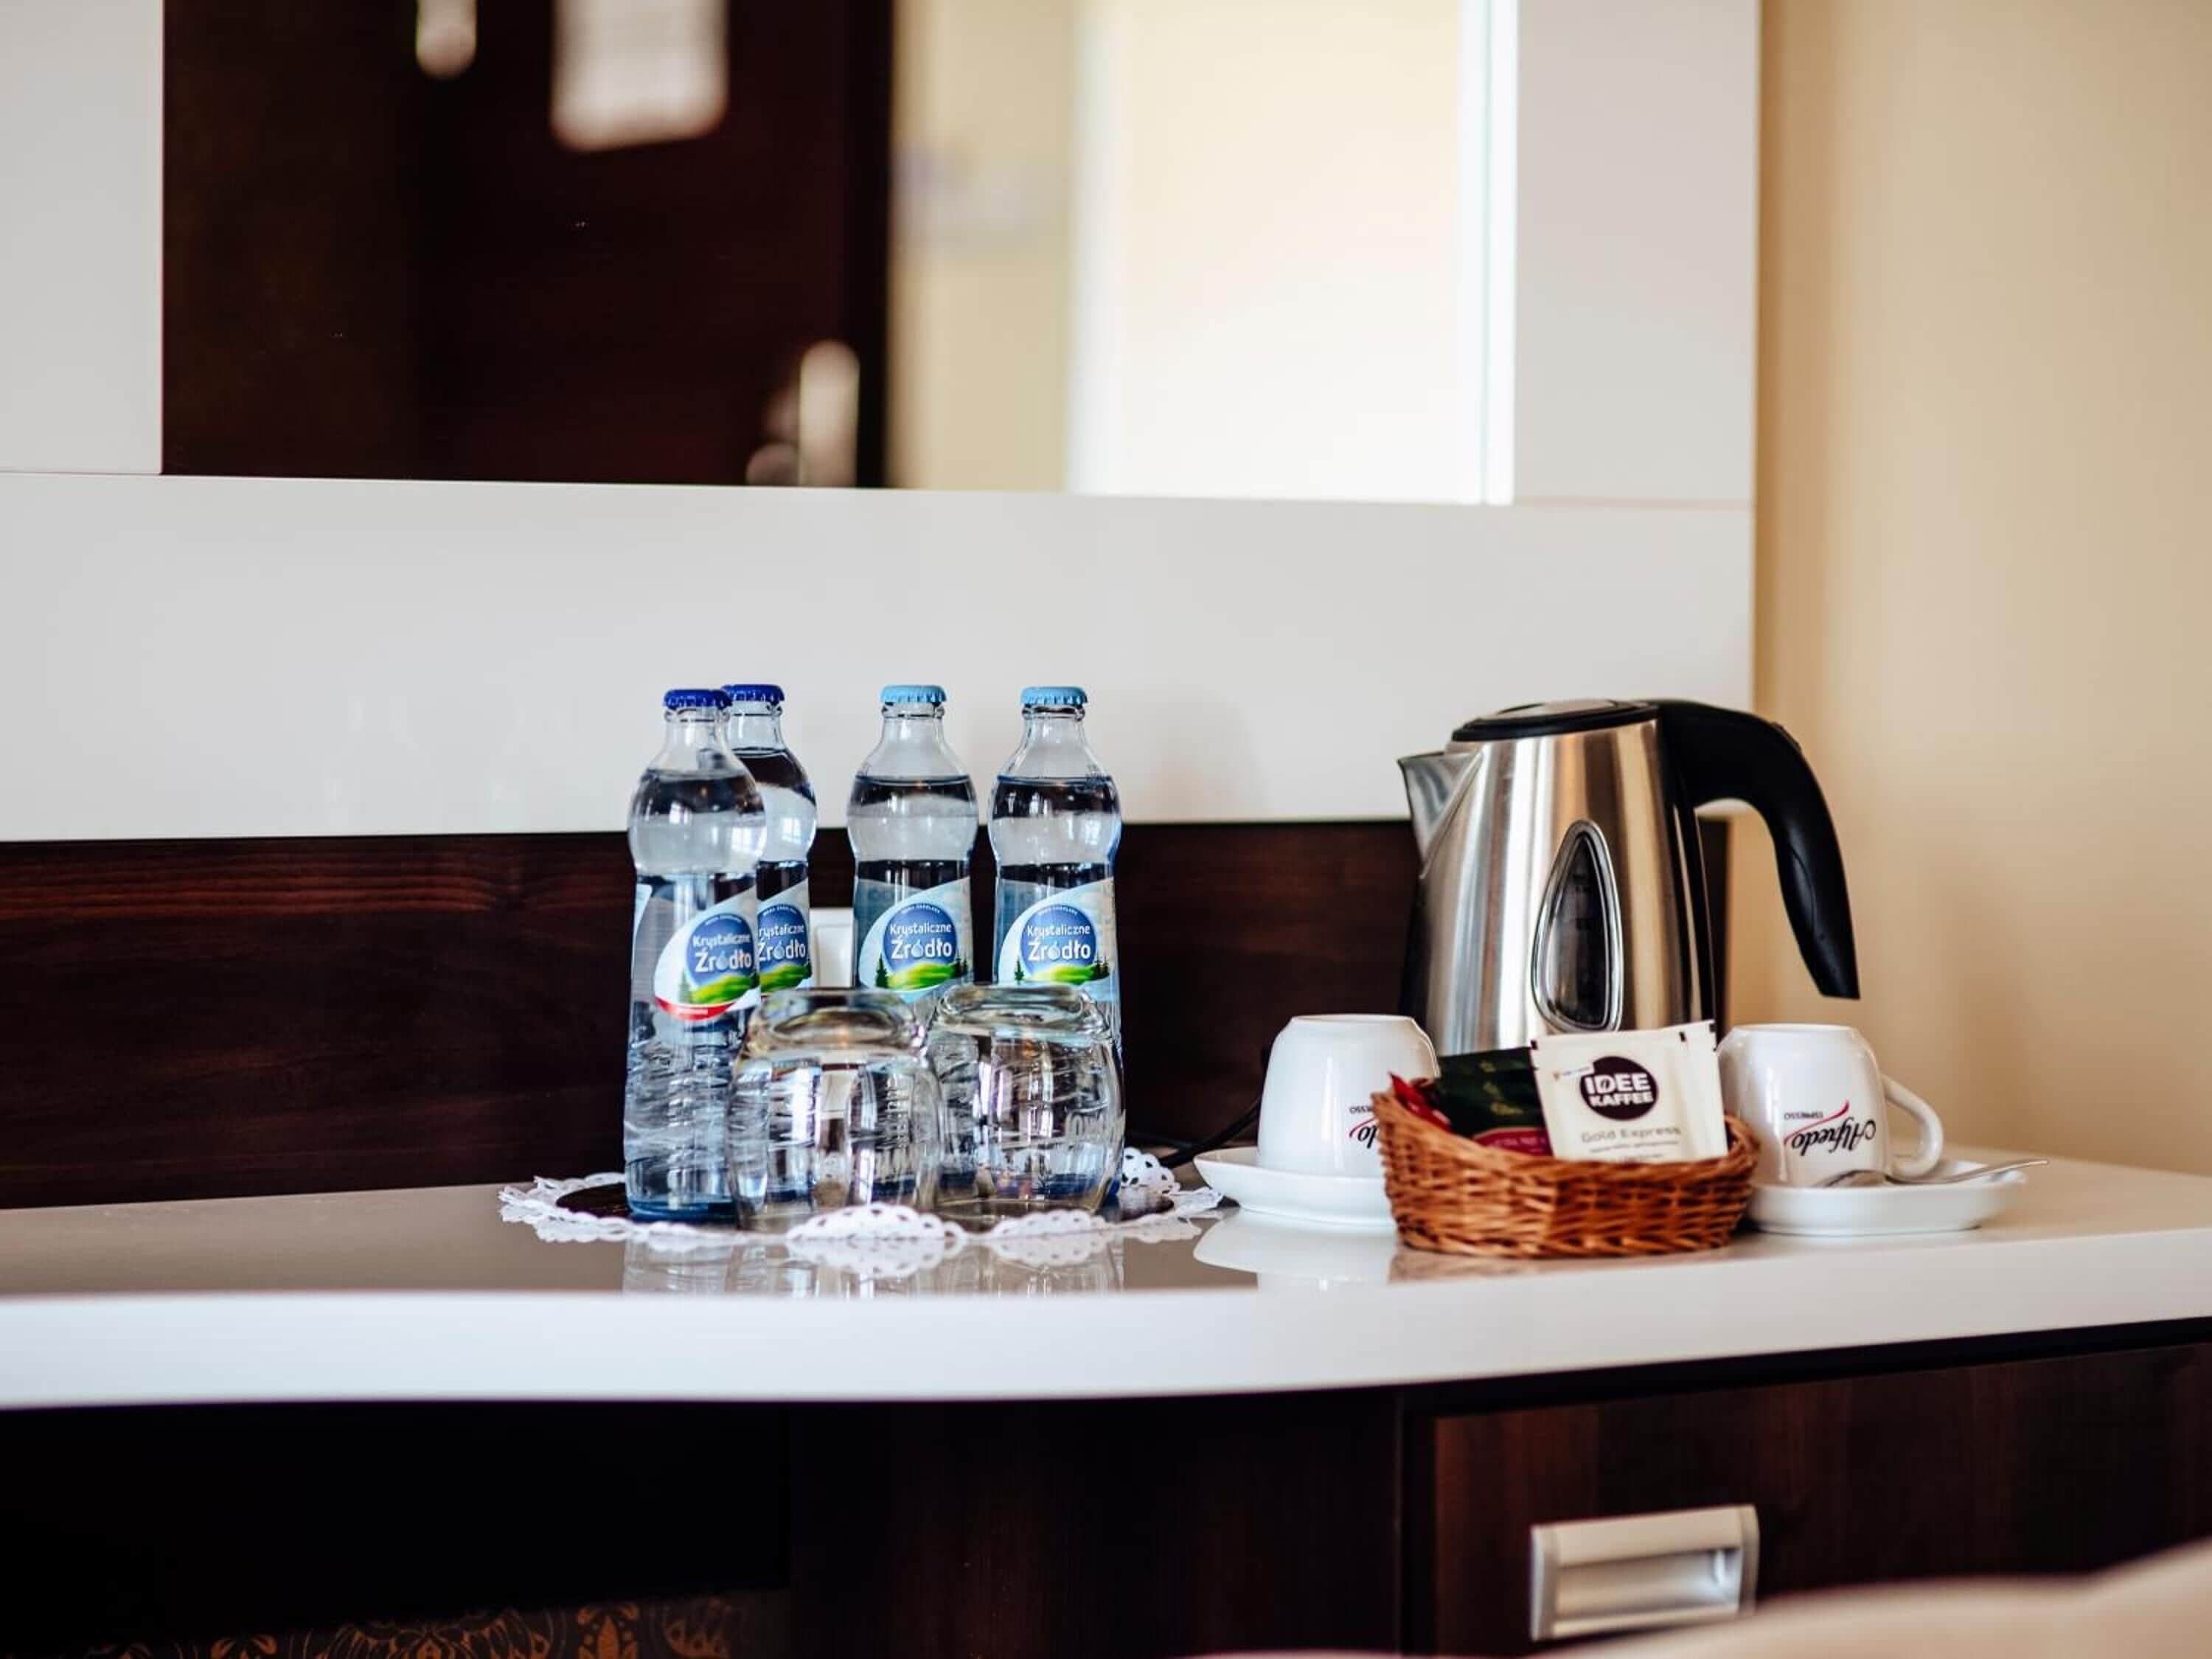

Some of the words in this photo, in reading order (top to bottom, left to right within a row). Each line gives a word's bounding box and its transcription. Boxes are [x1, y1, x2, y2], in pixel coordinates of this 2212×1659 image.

[759, 924, 804, 939] rystaliczne
[890, 922, 952, 937] Krystaliczne
[1027, 923, 1091, 938] Krystaliczne
[693, 933, 751, 950] Krystaliczne
[891, 934, 953, 959] Źródło
[1027, 936, 1091, 961] Źródło
[695, 948, 752, 973] Źródło
[1584, 1072, 1651, 1094] IDEE
[1588, 1091, 1654, 1107] KAFFEE
[1581, 1128, 1617, 1143] Gold
[1620, 1125, 1682, 1140] Express
[1791, 1116, 1877, 1157] Alfredo
